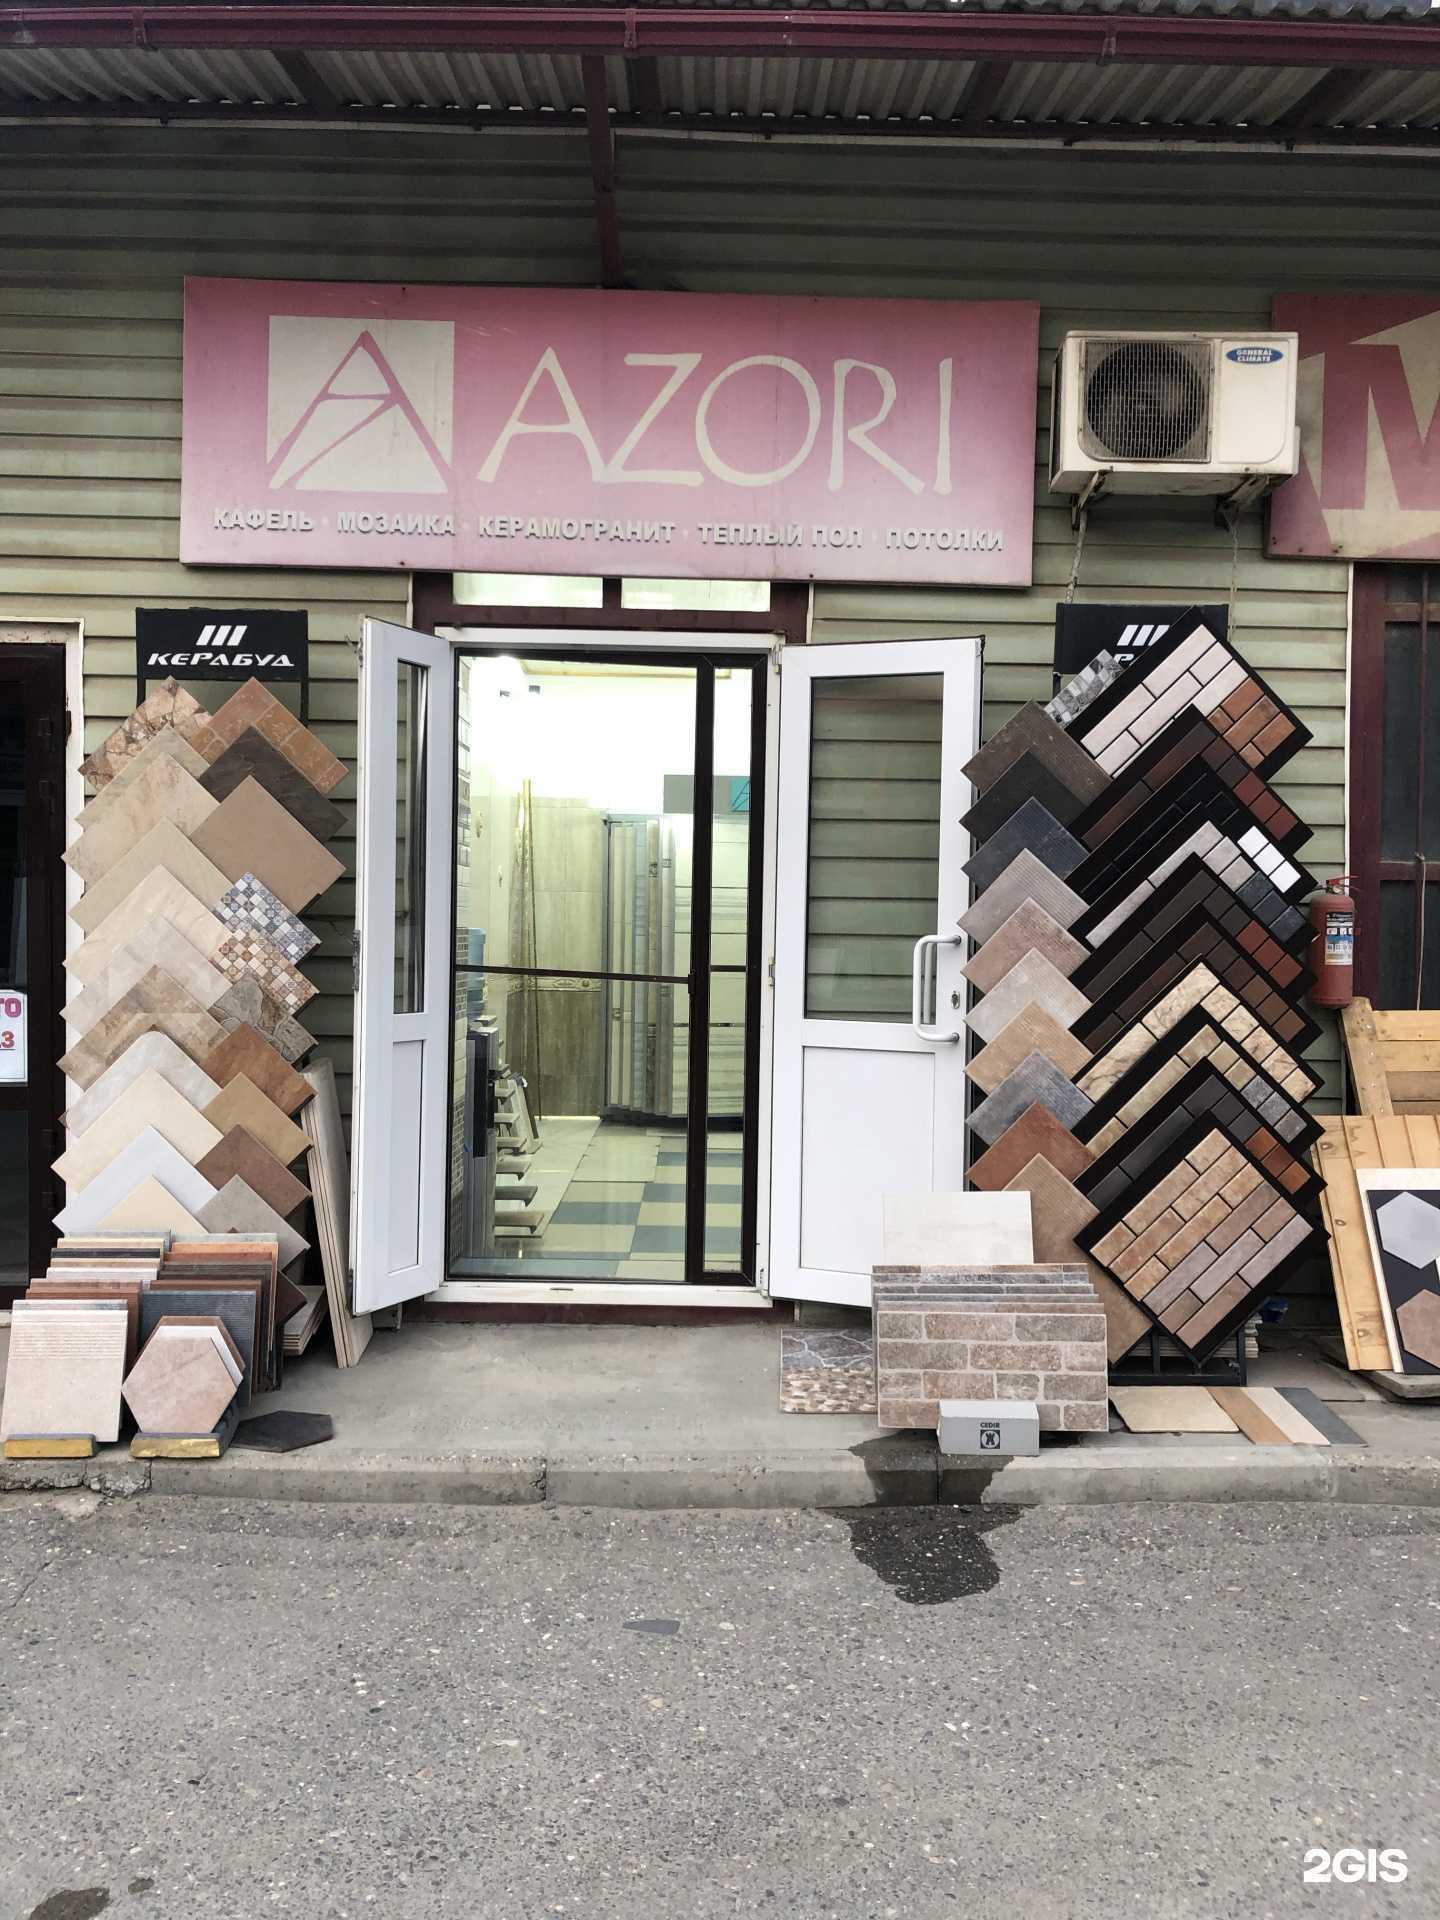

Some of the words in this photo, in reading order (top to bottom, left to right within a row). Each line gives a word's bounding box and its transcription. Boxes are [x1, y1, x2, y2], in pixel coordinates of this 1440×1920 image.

[1236, 348, 1273, 356] GENERAL
[1236, 355, 1272, 363] CLIMATE
[476, 345, 953, 495] AZORI
[213, 508, 315, 532] КАФЕЛЬ
[337, 511, 457, 536] МОЗАИКА
[479, 515, 676, 543] КЕРАМОГРАНИТ
[698, 522, 802, 547] ТЕПЛЫЙ
[811, 526, 864, 549] ПОЛ
[885, 528, 1004, 552] ПОТОЛКИ
